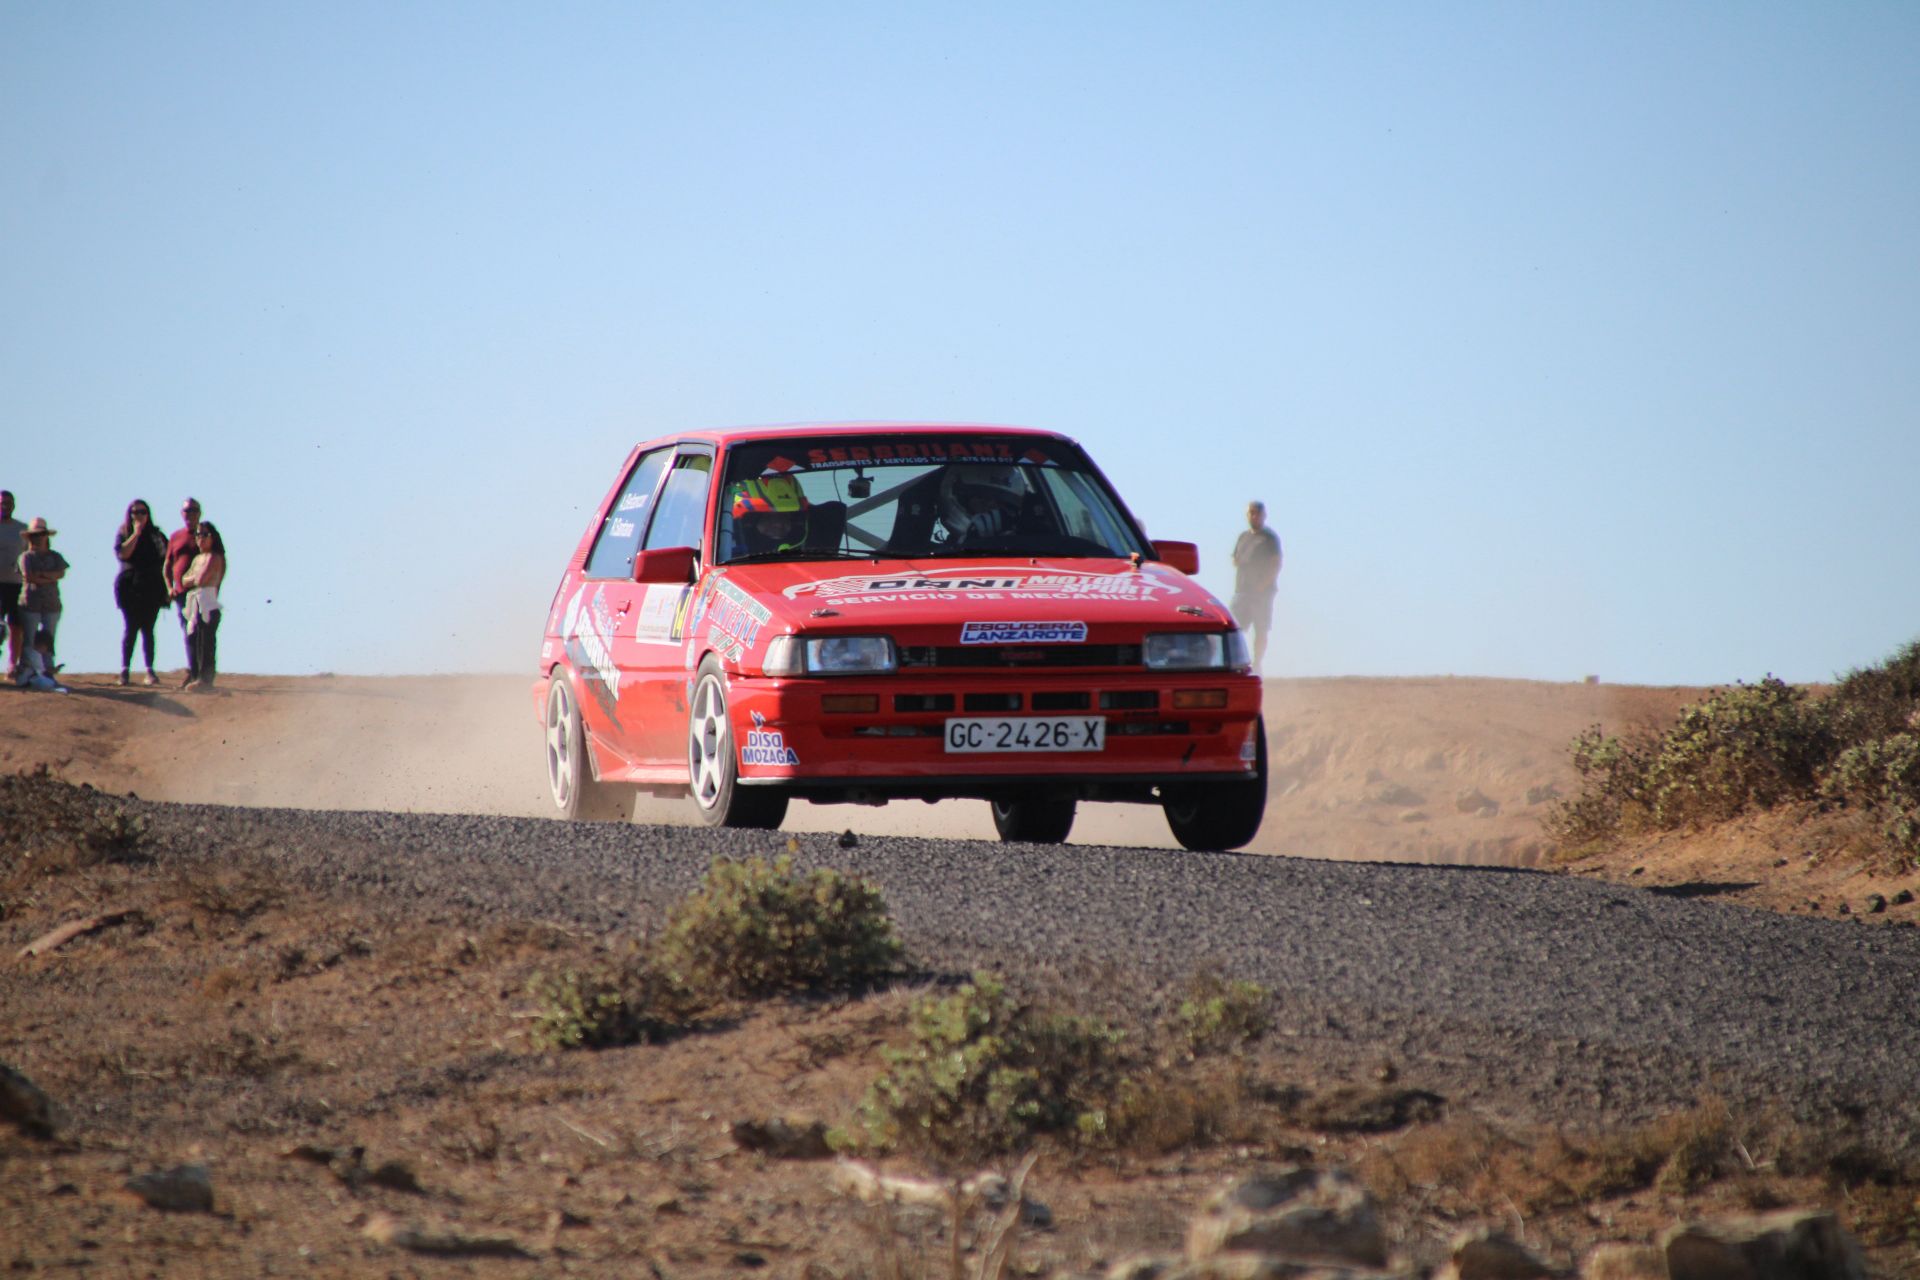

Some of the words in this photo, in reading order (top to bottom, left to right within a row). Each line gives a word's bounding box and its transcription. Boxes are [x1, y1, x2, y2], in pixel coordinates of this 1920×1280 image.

[866, 579, 1015, 590] DANI
[1027, 575, 1133, 585] MOTOR
[1060, 583, 1157, 595] SPORT
[825, 593, 958, 606] SERVICIO
[1010, 592, 1160, 602] MECANICA
[965, 622, 1085, 632] ESCUDERIA
[962, 630, 1085, 642] LANZAROTE
[950, 721, 1099, 749] GC-2426-X
[742, 748, 799, 764] MOZAGA
